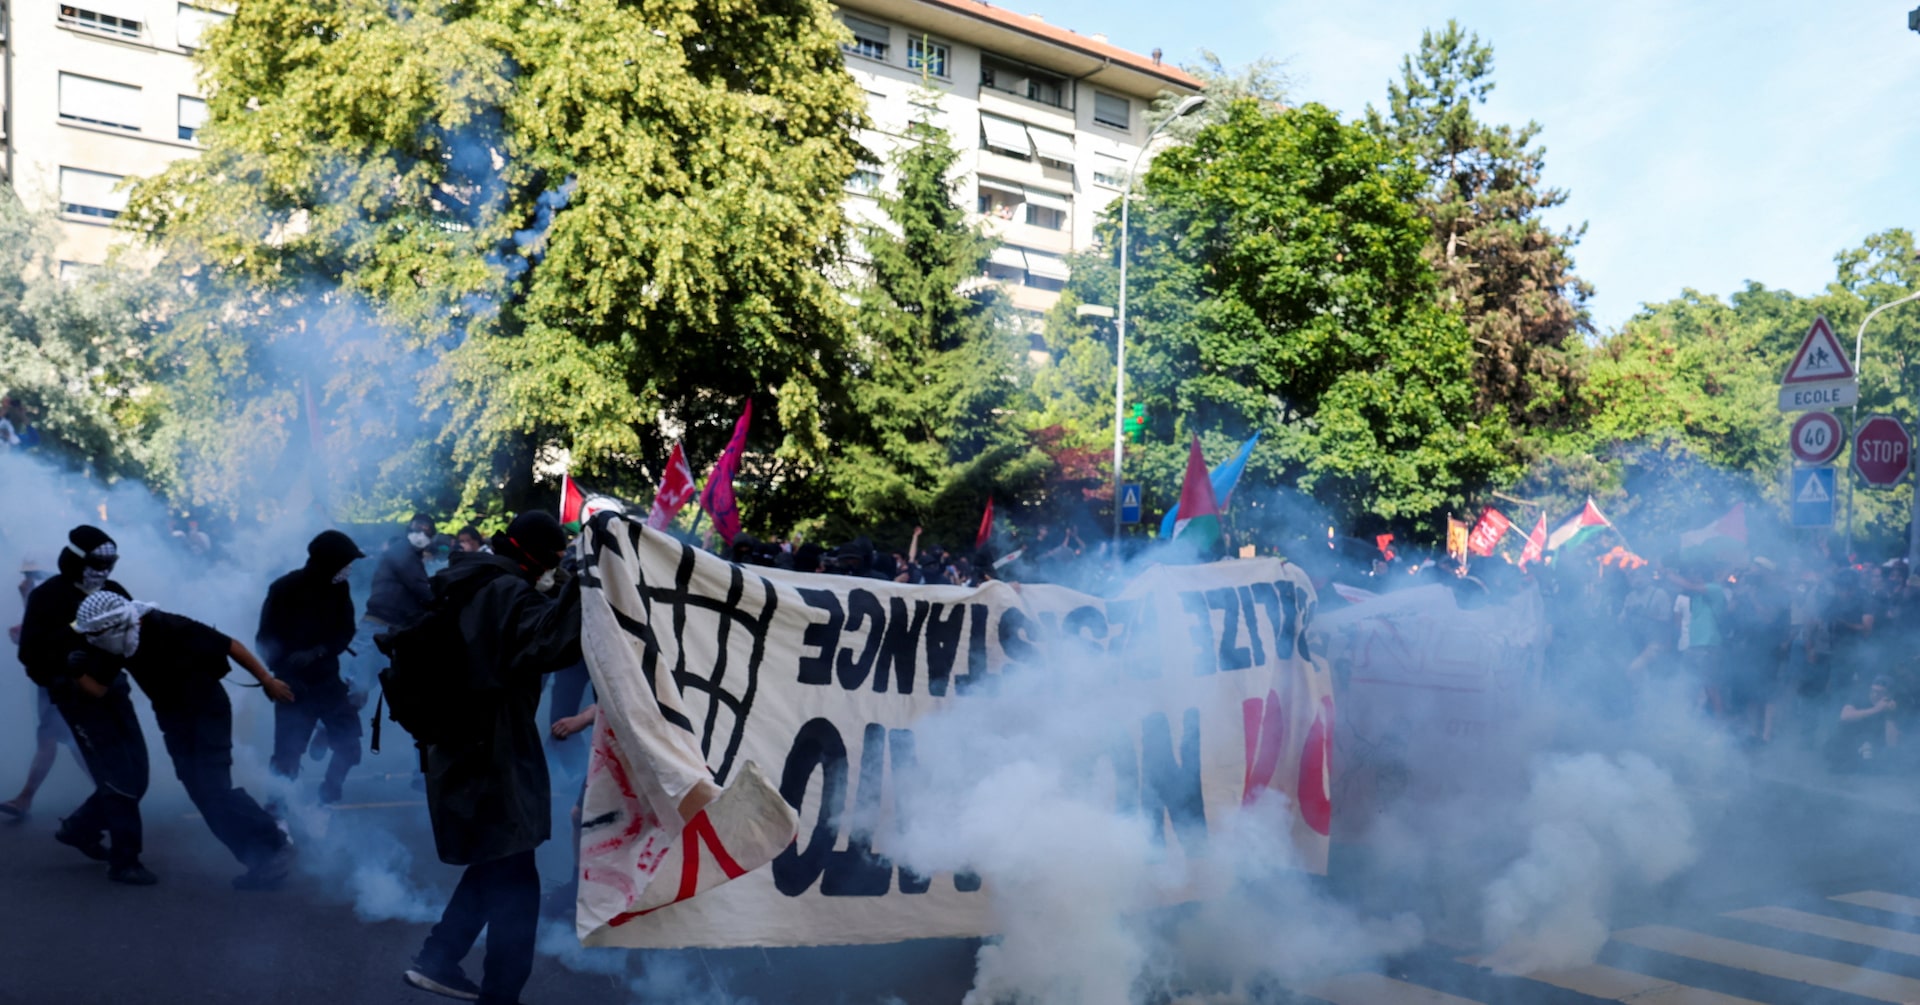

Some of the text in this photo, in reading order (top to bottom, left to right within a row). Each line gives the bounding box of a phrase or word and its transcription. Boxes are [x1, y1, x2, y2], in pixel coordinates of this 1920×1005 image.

[1795, 388, 1840, 405] ECOLE
[1804, 428, 1825, 446] 40
[1862, 440, 1904, 463] STOP
